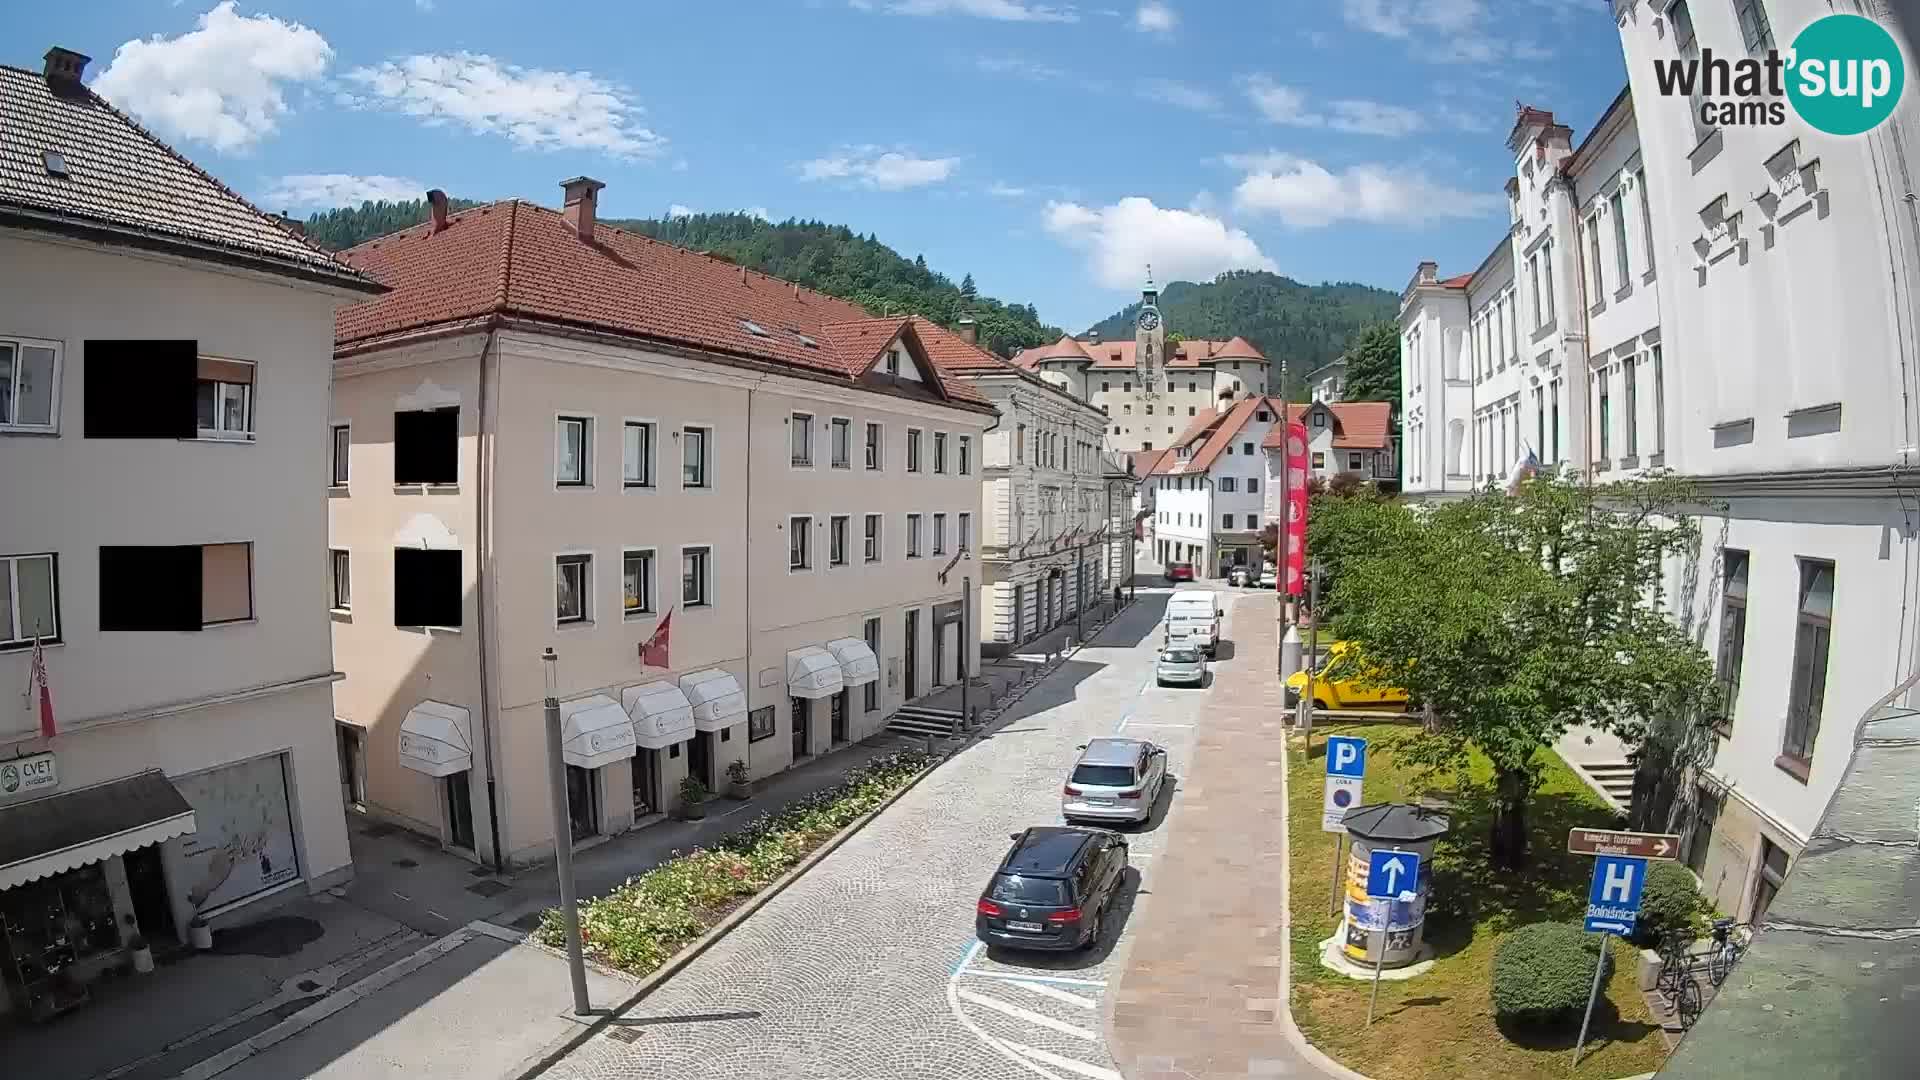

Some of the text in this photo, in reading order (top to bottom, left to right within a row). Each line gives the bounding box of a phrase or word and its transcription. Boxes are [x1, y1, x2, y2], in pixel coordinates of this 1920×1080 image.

[24, 760, 50, 776] CVET
[1335, 743, 1357, 770] P
[1601, 863, 1634, 903] H
